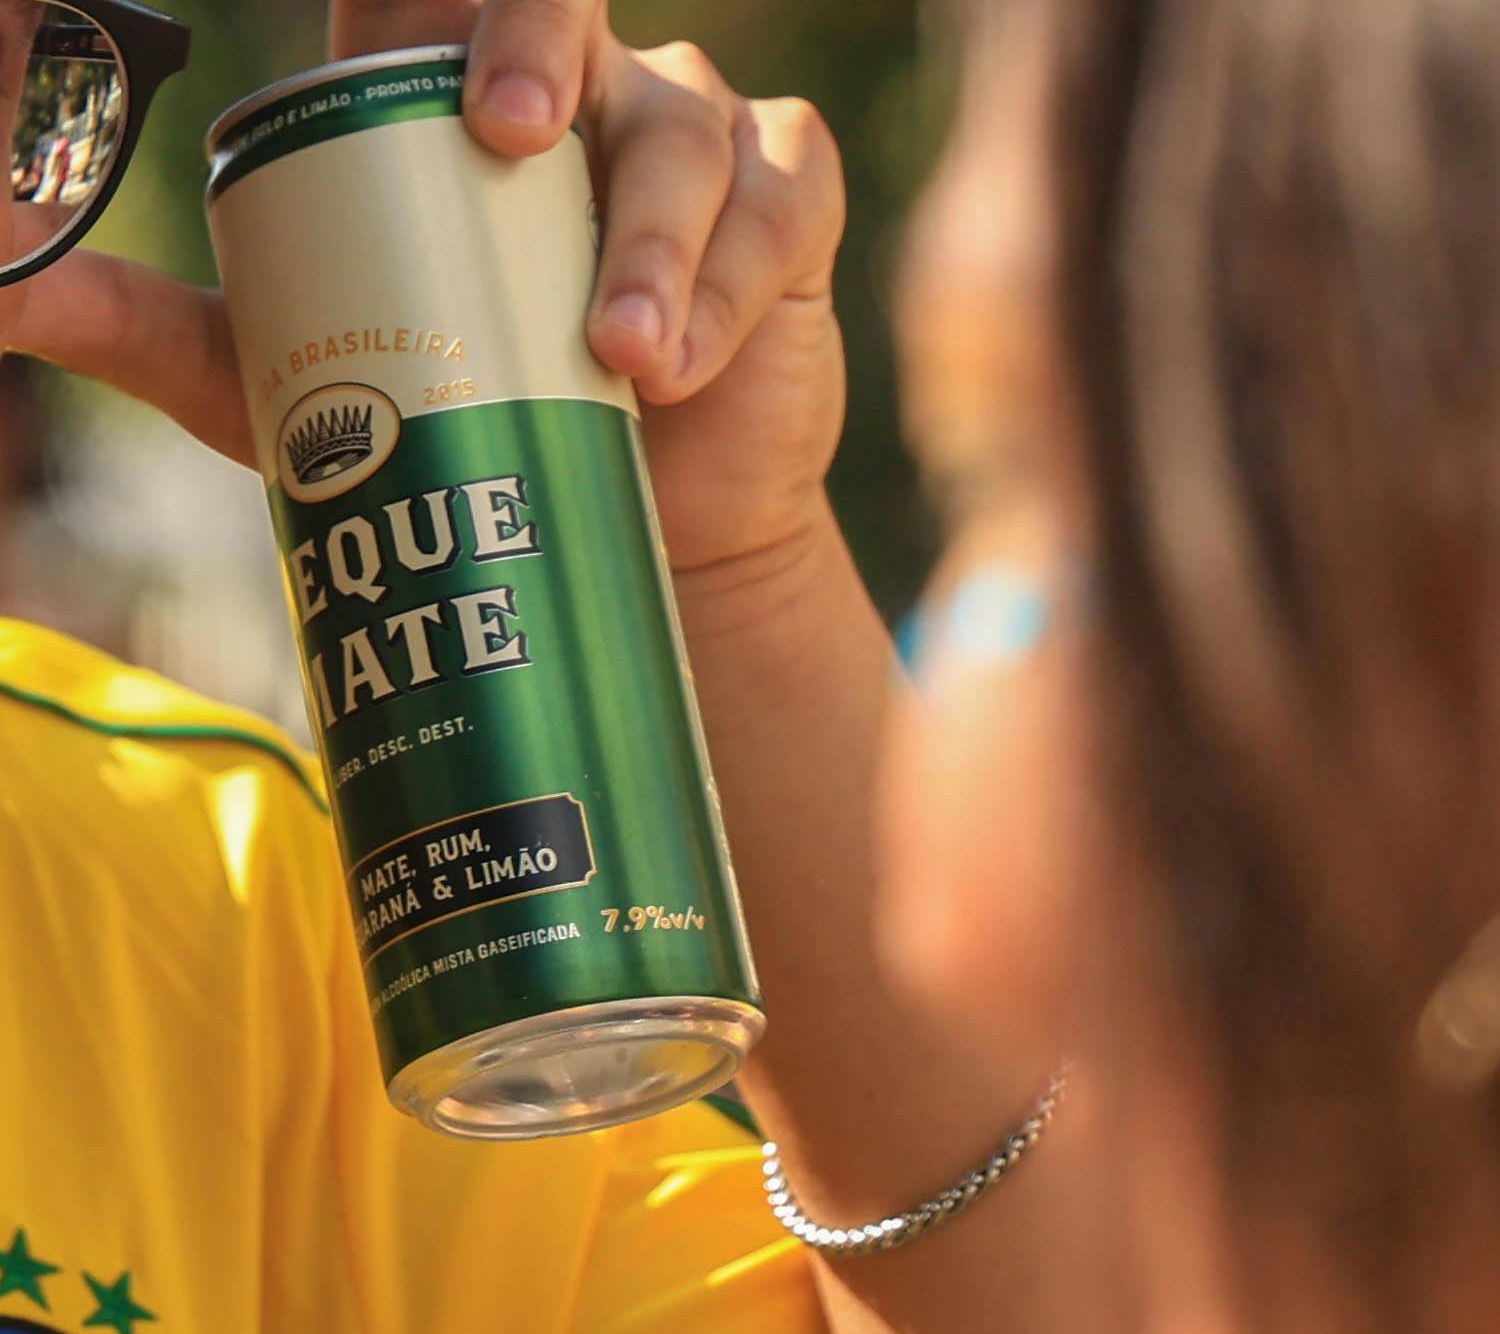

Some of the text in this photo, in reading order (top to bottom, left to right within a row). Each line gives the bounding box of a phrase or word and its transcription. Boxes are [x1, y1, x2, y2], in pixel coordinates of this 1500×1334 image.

[287, 108, 298, 124] E
[301, 92, 351, 119] LIMÃO
[365, 76, 433, 100] PRONTO
[288, 327, 465, 375] BRASILEIRA
[423, 377, 477, 407] 2015
[368, 735, 414, 766] DESC.
[418, 716, 474, 744] DEST.
[360, 828, 491, 902] MATE, RUM,
[432, 874, 454, 901] &
[465, 847, 558, 891] LIMÃO
[432, 948, 475, 976] MISTA
[477, 922, 581, 960] GASEIFICADA
